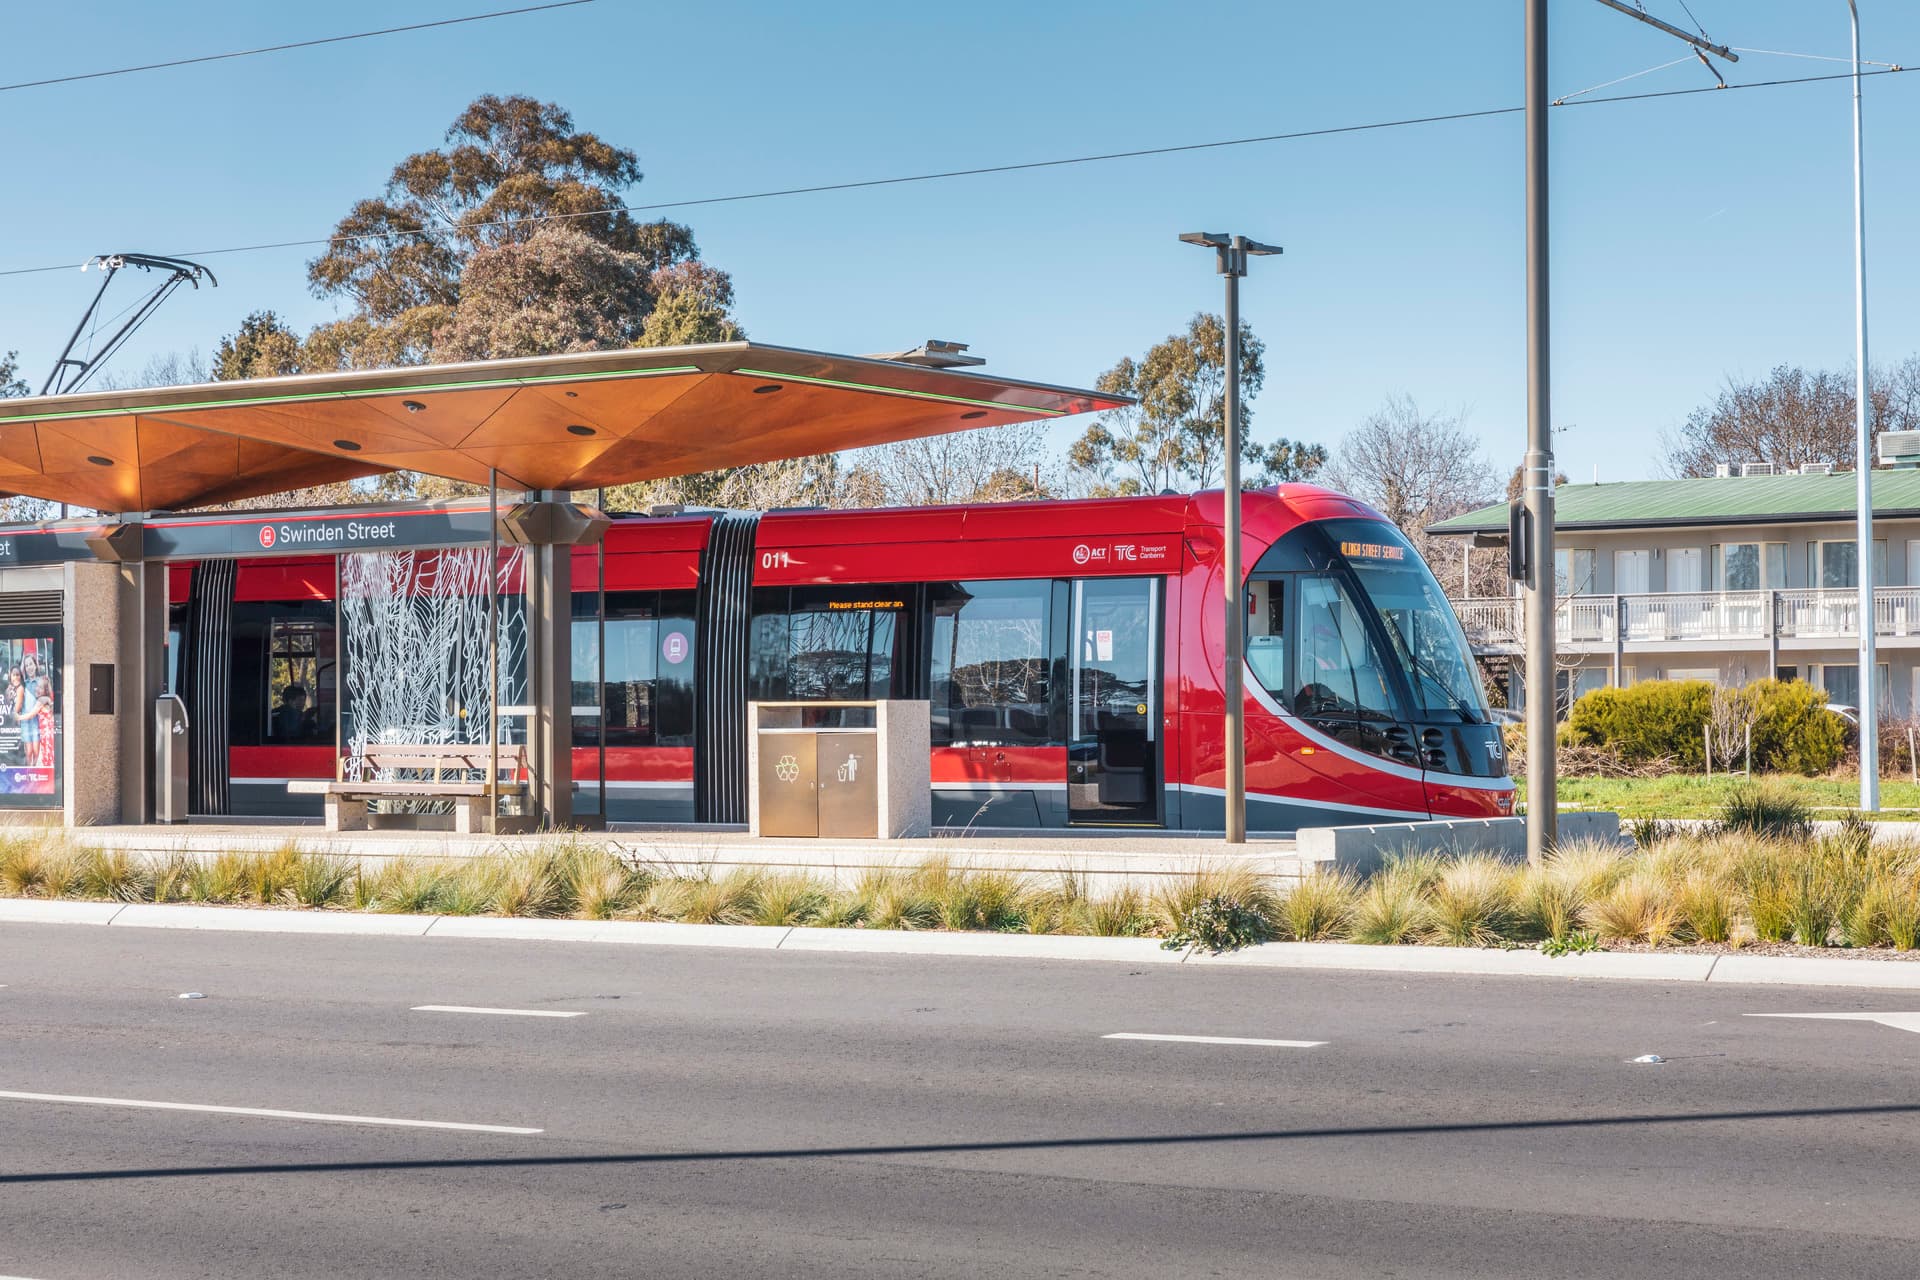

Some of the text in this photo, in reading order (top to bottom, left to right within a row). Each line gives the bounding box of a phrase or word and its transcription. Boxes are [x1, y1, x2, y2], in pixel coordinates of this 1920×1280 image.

[280, 522, 396, 543] Swinden Street
[1091, 548, 1107, 556] ACT
[762, 552, 789, 569] 011
[829, 601, 852, 609] Please
[853, 601, 873, 609] stand
